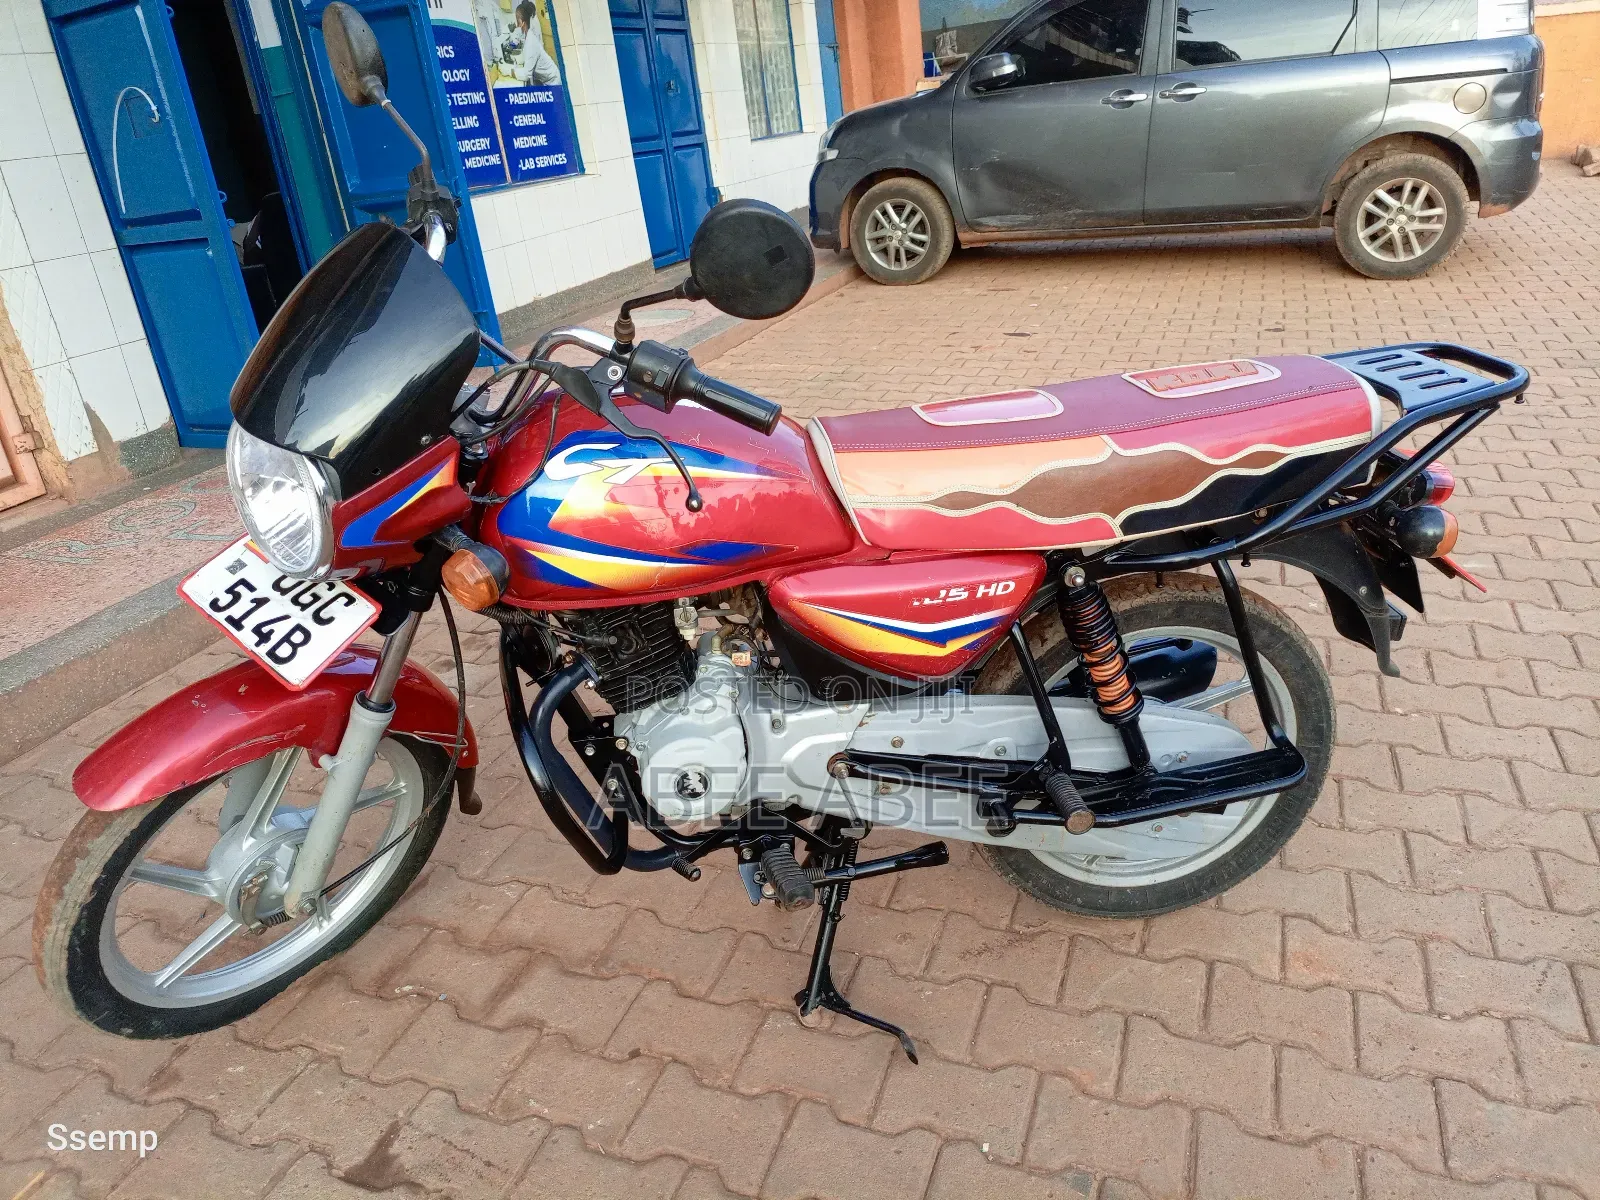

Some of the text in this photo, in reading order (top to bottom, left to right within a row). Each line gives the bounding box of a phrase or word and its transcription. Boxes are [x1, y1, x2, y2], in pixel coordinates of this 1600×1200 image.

[442, 69, 470, 83] OLOGY
[451, 91, 486, 106] TESTING
[508, 91, 554, 105] PAEDIATRICS
[513, 113, 546, 127] GENERAL
[513, 134, 548, 149] MEDICINE
[464, 153, 501, 169] MEDICINE
[535, 152, 567, 168] SERVICES
[976, 580, 1016, 598] HD
[208, 577, 312, 666] 514B
